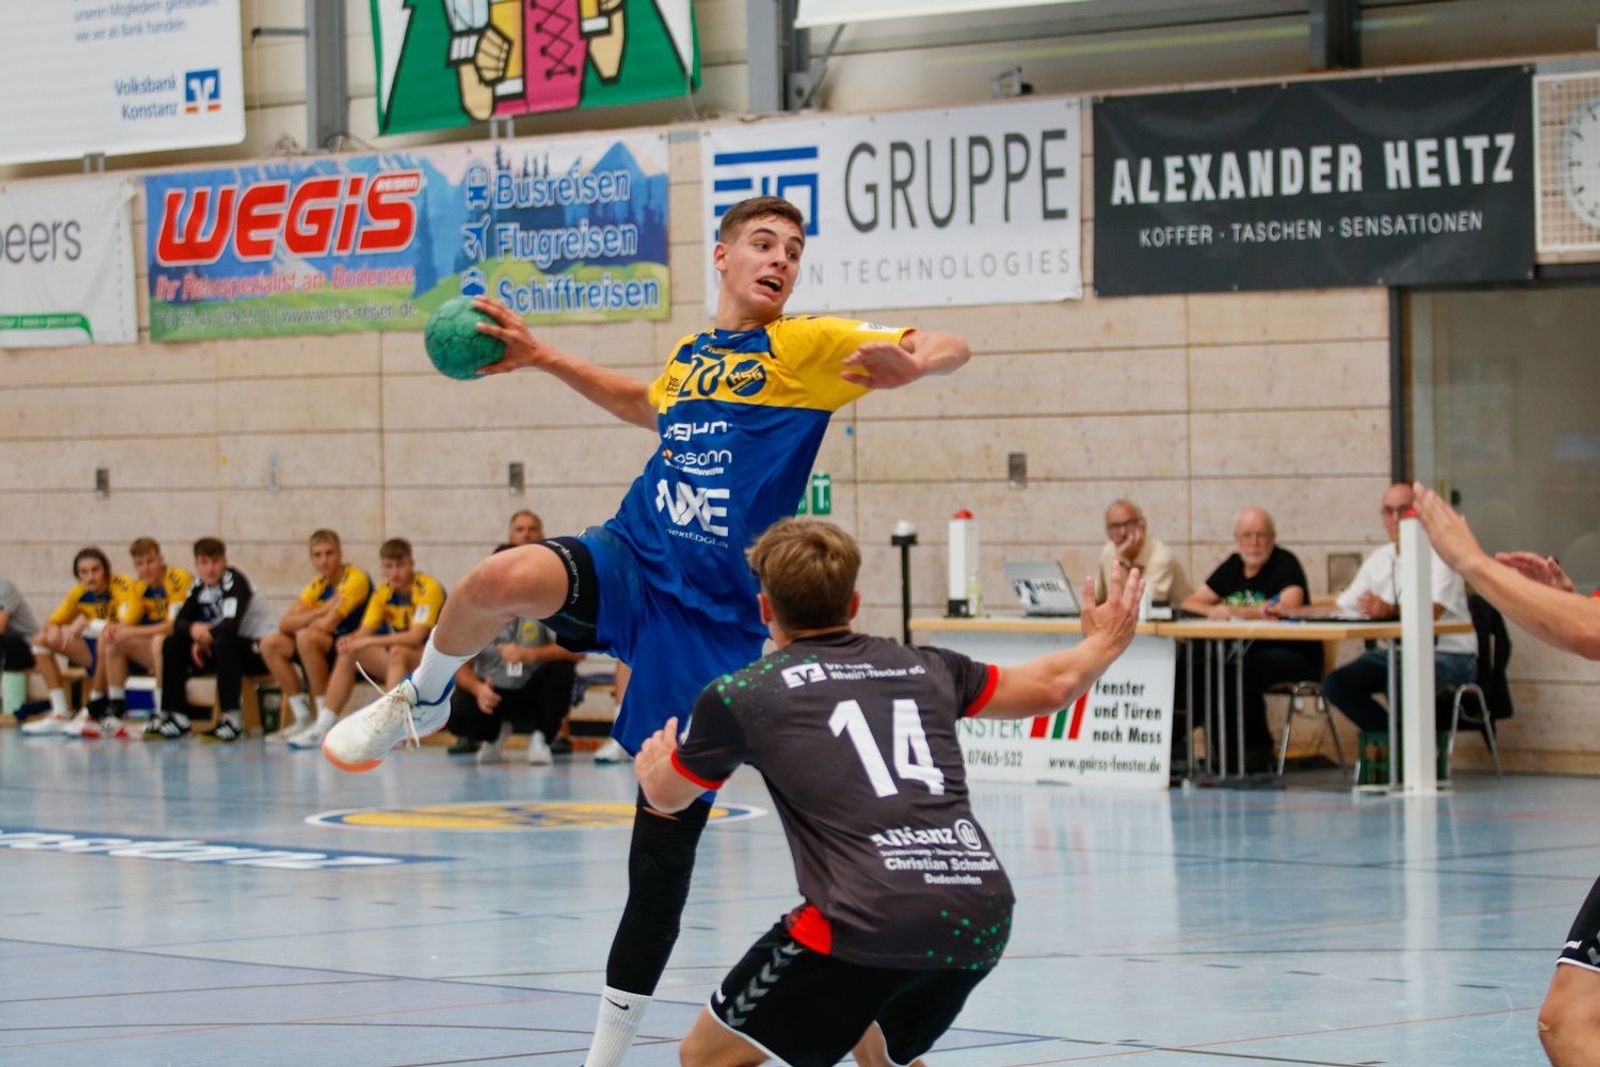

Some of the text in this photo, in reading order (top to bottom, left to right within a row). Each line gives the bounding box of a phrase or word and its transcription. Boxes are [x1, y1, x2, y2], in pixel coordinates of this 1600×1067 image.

[114, 73, 178, 96] Volksbank
[121, 102, 179, 120] Konstanz
[496, 168, 631, 206] Busreisen
[844, 129, 1069, 234] GRUPPE
[1111, 143, 1363, 206] ALEXANDER
[1383, 134, 1516, 190] HEITZ
[0, 220, 82, 264] eers
[496, 219, 638, 267] Flugreisen
[1140, 211, 1483, 248] KOFFER TASCHEN SENSATIONEN
[840, 249, 1071, 286] TECHNOLOGIES
[499, 272, 660, 313] Schiffreisen
[678, 357, 725, 396] 20
[1095, 679, 1146, 697] Fenster
[957, 717, 1024, 739] NSTER
[1094, 703, 1162, 720] und Türen
[828, 699, 945, 798] 14
[1093, 728, 1162, 744] nach Mass
[968, 751, 1023, 768] 07465-532
[870, 826, 958, 847] Allianz
[884, 857, 949, 870] Christian
